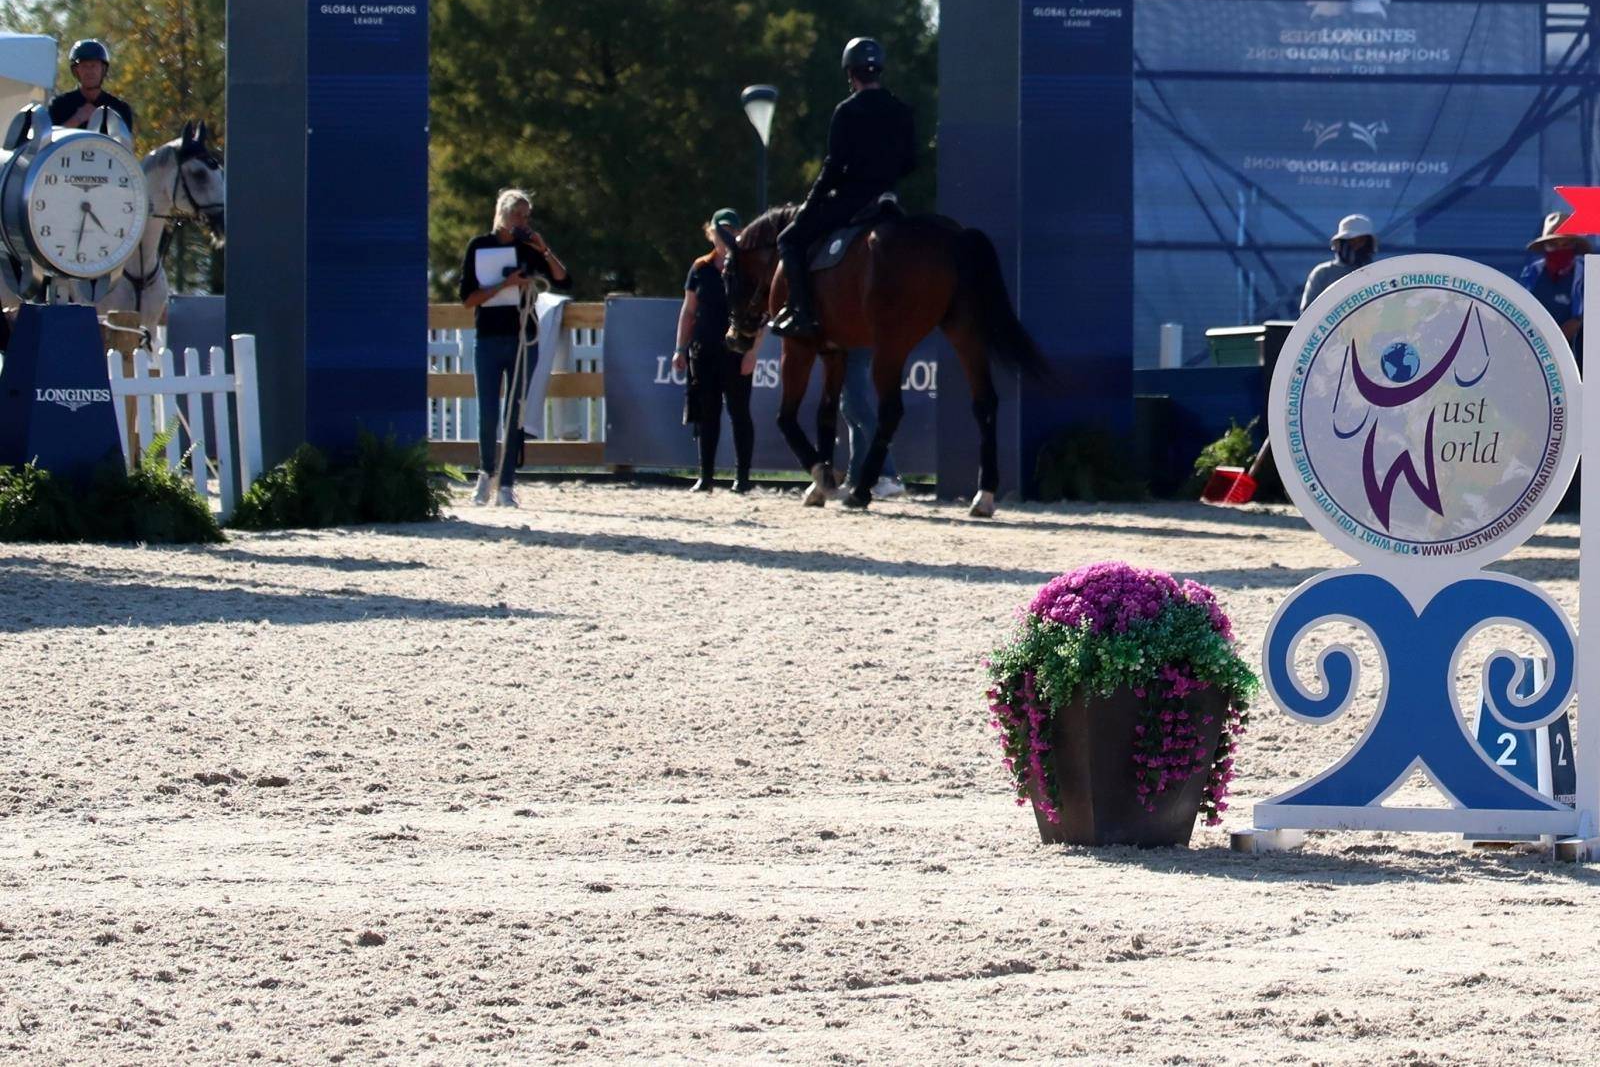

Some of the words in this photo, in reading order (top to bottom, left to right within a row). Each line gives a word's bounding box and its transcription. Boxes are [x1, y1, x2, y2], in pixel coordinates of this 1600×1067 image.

[320, 4, 358, 15] GLOBAL
[359, 5, 417, 15] CHAMPIONS
[1032, 6, 1068, 17] GLOBAL
[1068, 7, 1122, 18] CHAMPIONS
[353, 17, 384, 25] LEAGUE
[1321, 28, 1417, 44] LONGINES
[1286, 47, 1350, 61] GLOBAL
[1353, 48, 1450, 62] CHAMPIONS
[1351, 65, 1386, 74] TOUR
[61, 157, 70, 168] 11
[81, 151, 94, 162] 12
[108, 159, 113, 169] 1
[1287, 160, 1349, 173] GLOBAL
[1353, 161, 1449, 174] CHAMPIONS
[45, 174, 57, 185] 10
[64, 175, 109, 184] LONGINES
[119, 177, 128, 188] 2
[1344, 178, 1392, 188] LEAGUE
[36, 199, 46, 212] 9
[122, 202, 134, 214] 3
[40, 225, 51, 237] 8
[114, 228, 125, 239] 4
[56, 245, 66, 257] 7
[98, 246, 109, 257] 5
[76, 252, 87, 264] 6
[1400, 274, 1449, 286] CHANGE
[1452, 277, 1484, 296] LIVES
[1485, 290, 1531, 331] FOREVER
[1298, 332, 1321, 366] MAKE
[1318, 324, 1328, 335] A
[1325, 281, 1388, 326] DIFFERENCE
[1533, 337, 1552, 363] GIVE
[1544, 362, 1563, 396] BACK
[35, 388, 111, 402] LONGINES
[1288, 377, 1303, 420] CAUSE
[1288, 421, 1300, 434] A
[1288, 434, 1301, 454] FOR
[1295, 458, 1314, 483] RIDE
[1422, 406, 1564, 556] WWW.JUSTWORLDINTERNATIONAL.ORG
[1314, 492, 1341, 518] LOVE
[1337, 516, 1359, 535] YOU
[1359, 533, 1391, 550] WHAT
[1394, 544, 1410, 555] DO
[1496, 732, 1517, 766] 2
[1555, 733, 1567, 766] 2
